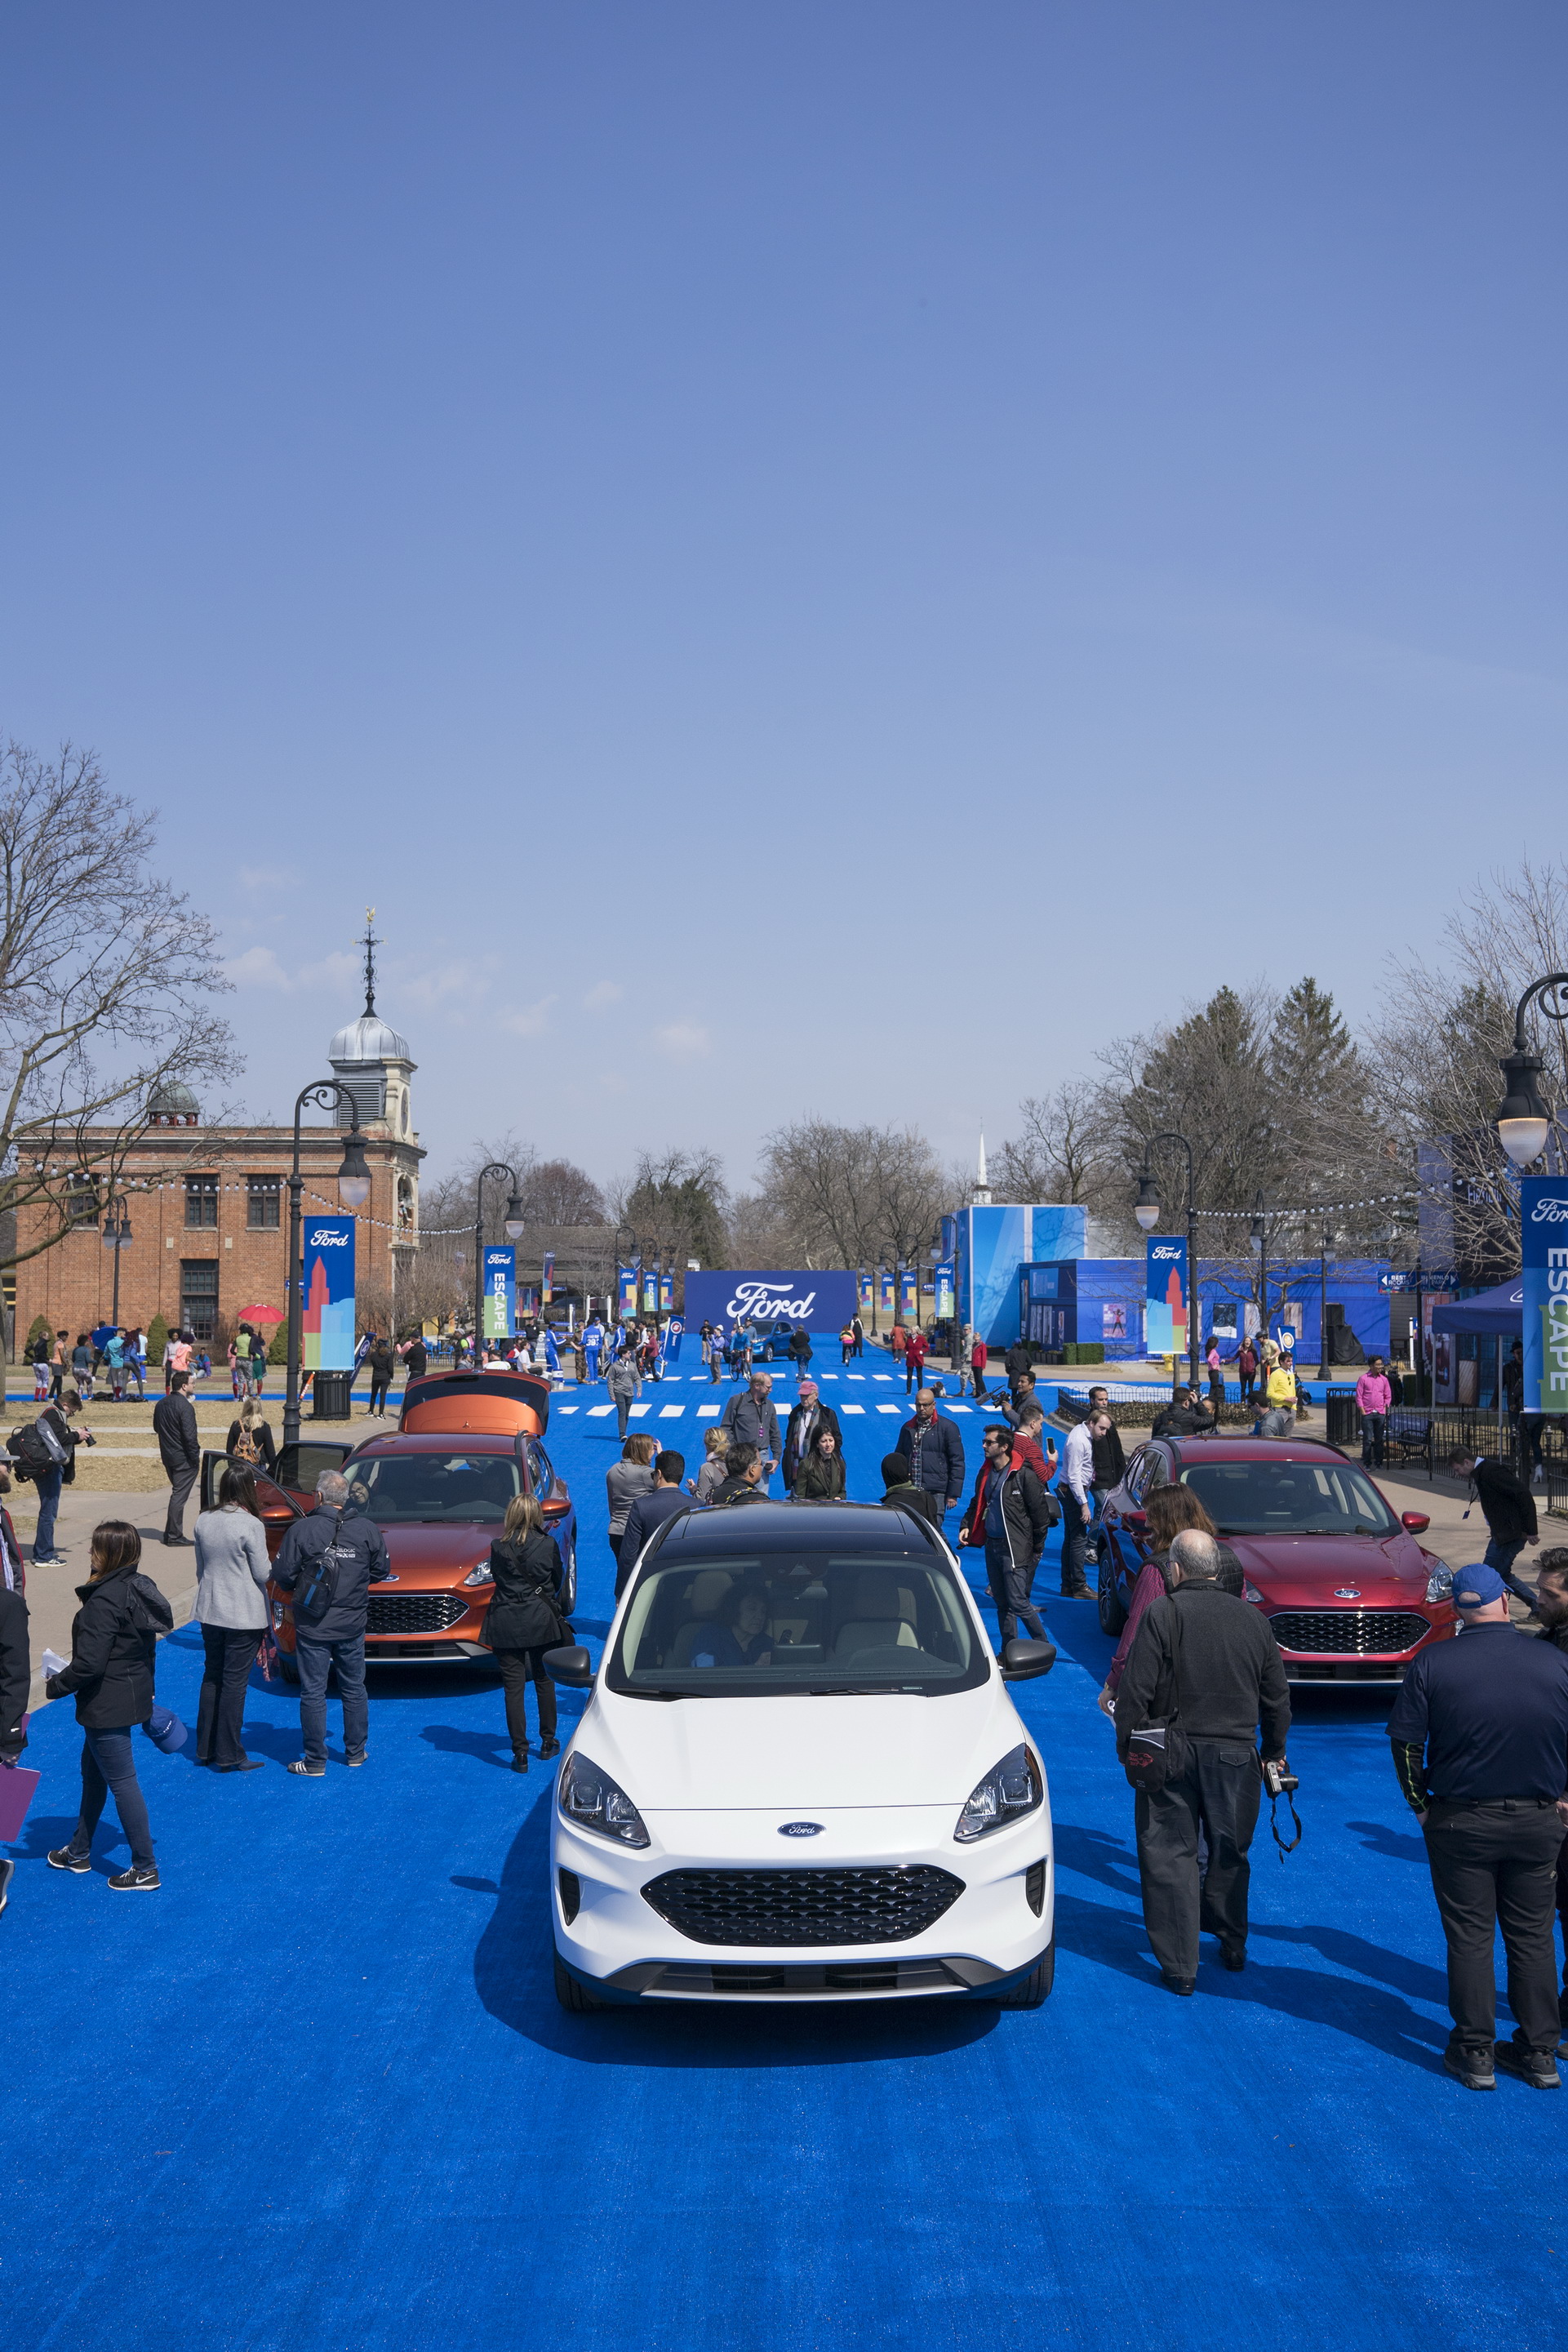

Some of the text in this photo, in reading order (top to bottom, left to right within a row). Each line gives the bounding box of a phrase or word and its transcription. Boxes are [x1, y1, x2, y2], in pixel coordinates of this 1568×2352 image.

[1530, 1198, 1568, 1222] For
[310, 1229, 349, 1247] Ford
[487, 1253, 512, 1265] Ford
[1152, 1246, 1182, 1260] Ford
[494, 1273, 505, 1330] ESCAPE
[726, 1282, 816, 1318] Ford
[940, 1278, 948, 1313] ESCAPE
[1548, 1247, 1568, 1391] ESCAPE
[788, 1825, 815, 1834] Ford
